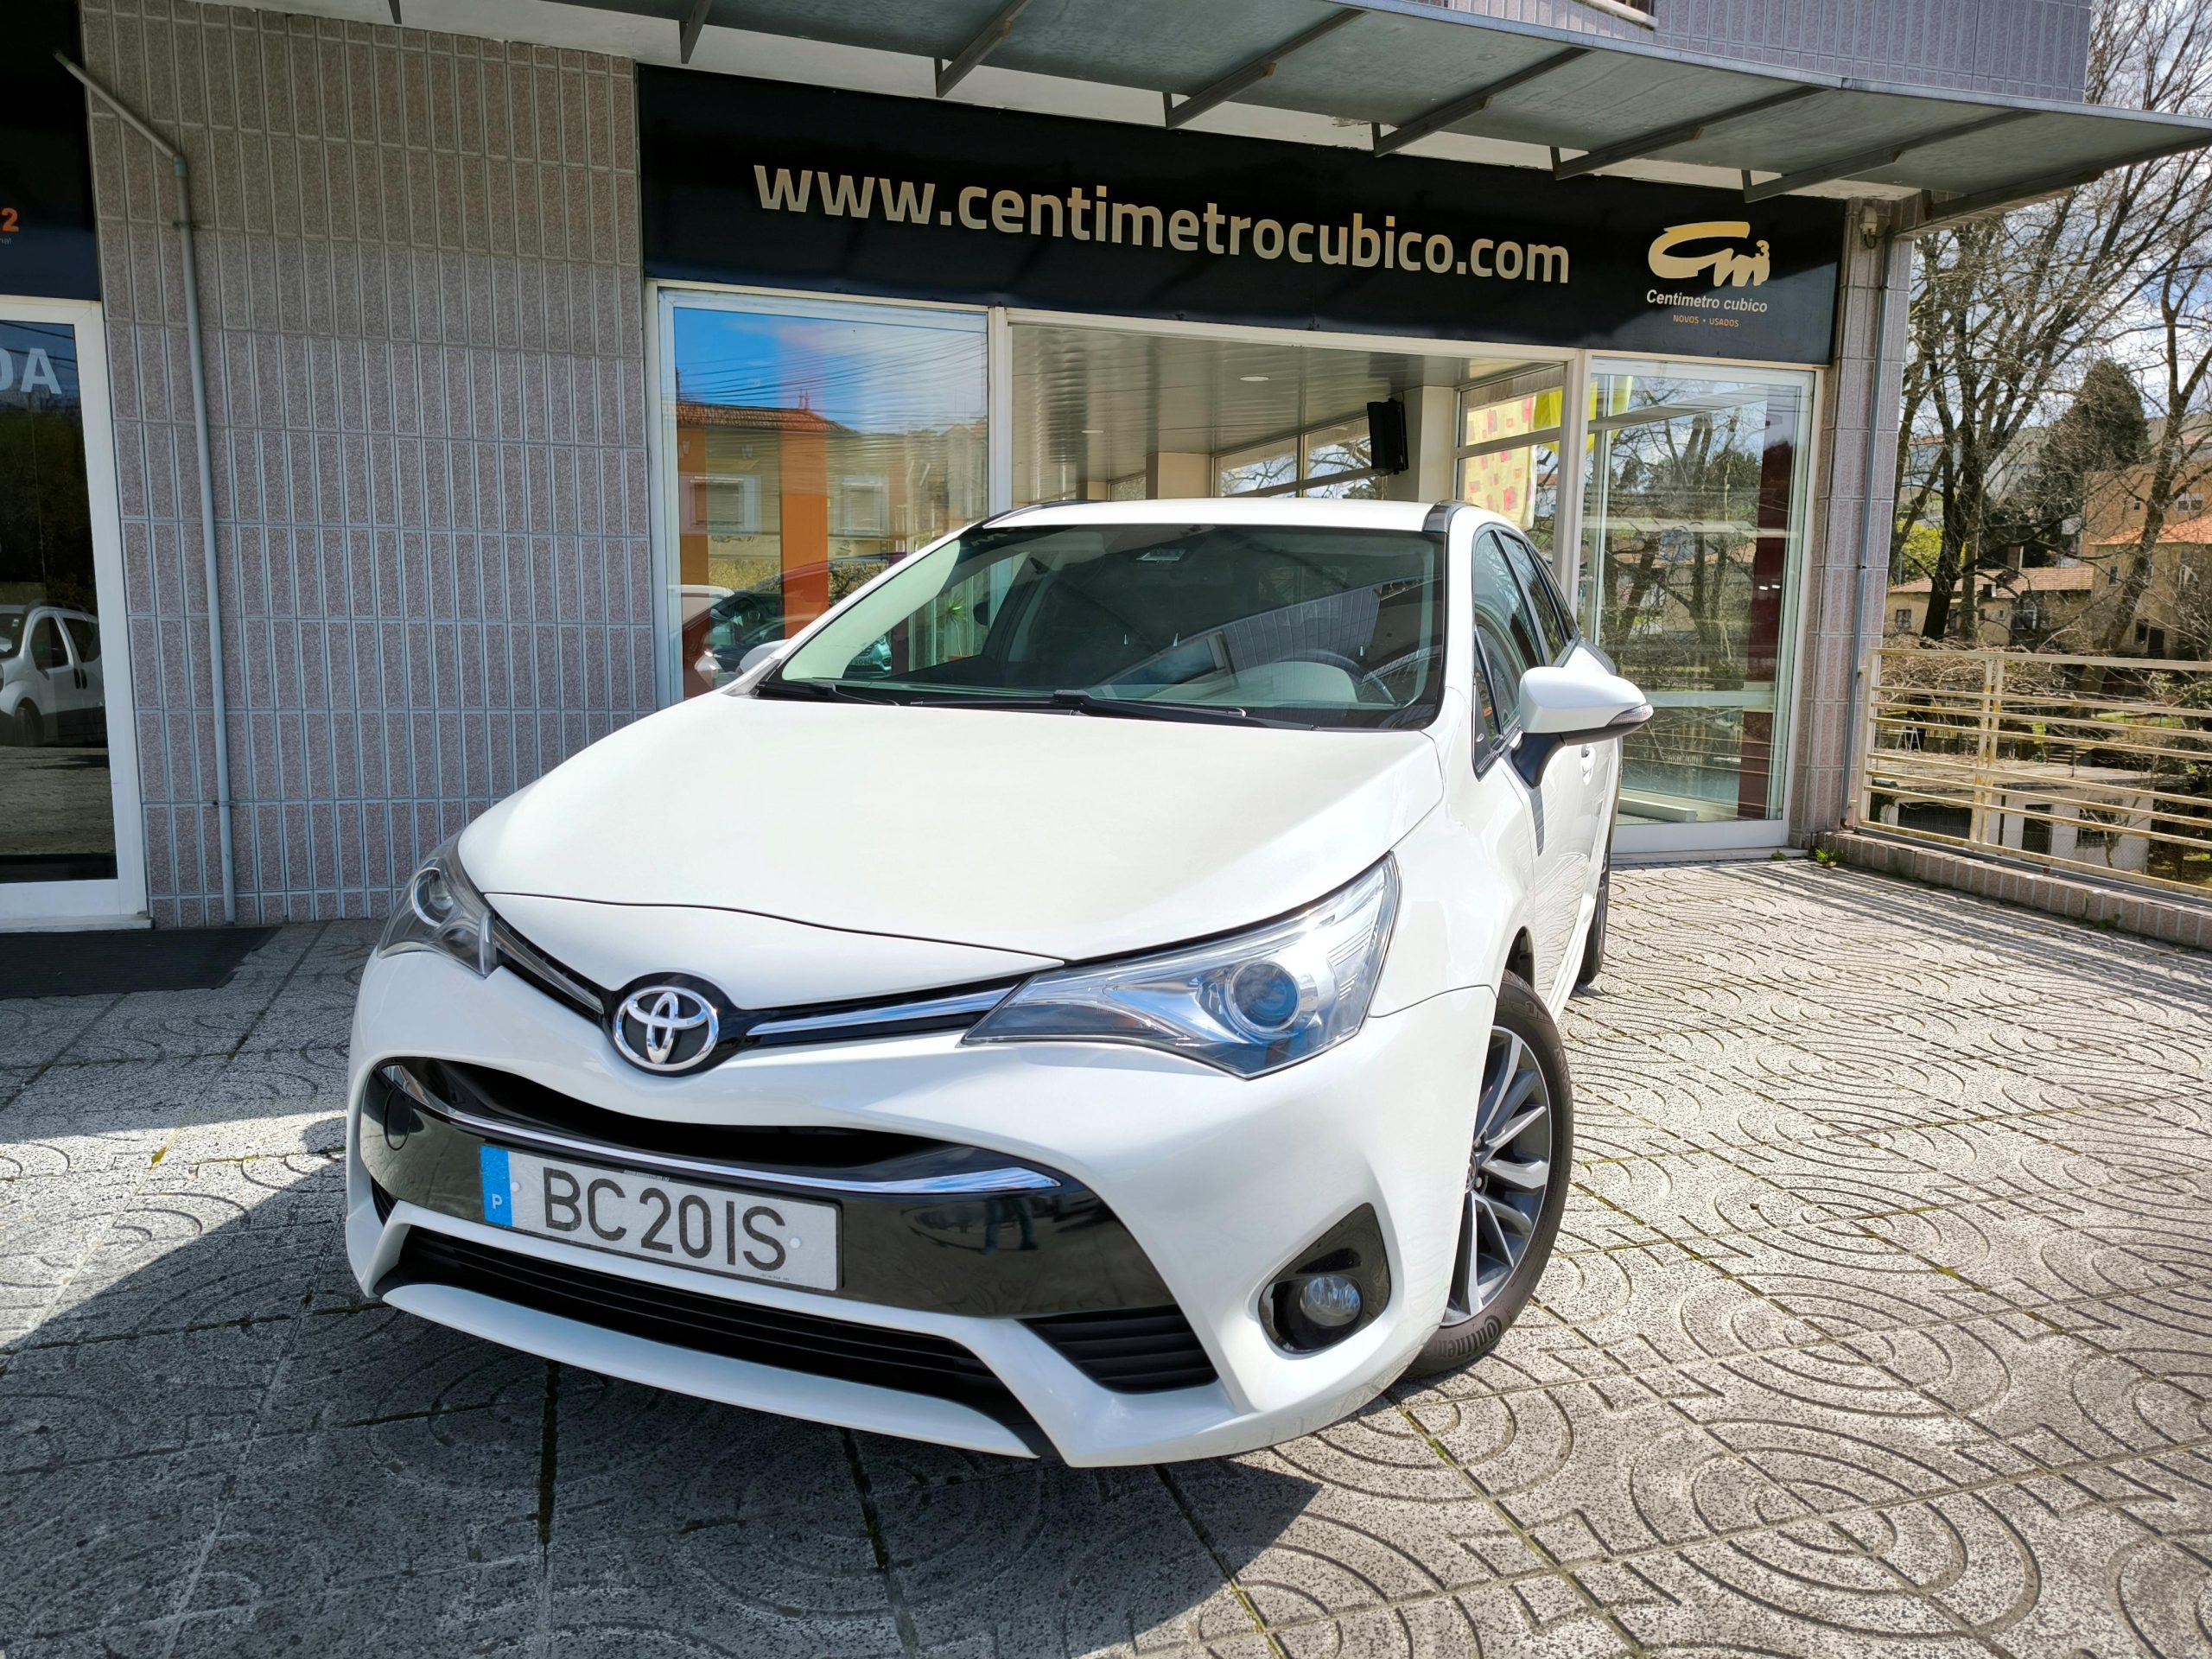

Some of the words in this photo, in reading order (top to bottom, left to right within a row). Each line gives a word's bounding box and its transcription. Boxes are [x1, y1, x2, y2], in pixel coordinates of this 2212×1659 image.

[753, 165, 1569, 283] www.centimetrocubico.com
[1646, 289, 1720, 309] Centimetro
[1723, 297, 1768, 313] cubico
[1673, 315, 1700, 324] NOVOS
[1709, 317, 1739, 327] USADOS
[492, 1193, 503, 1210] P
